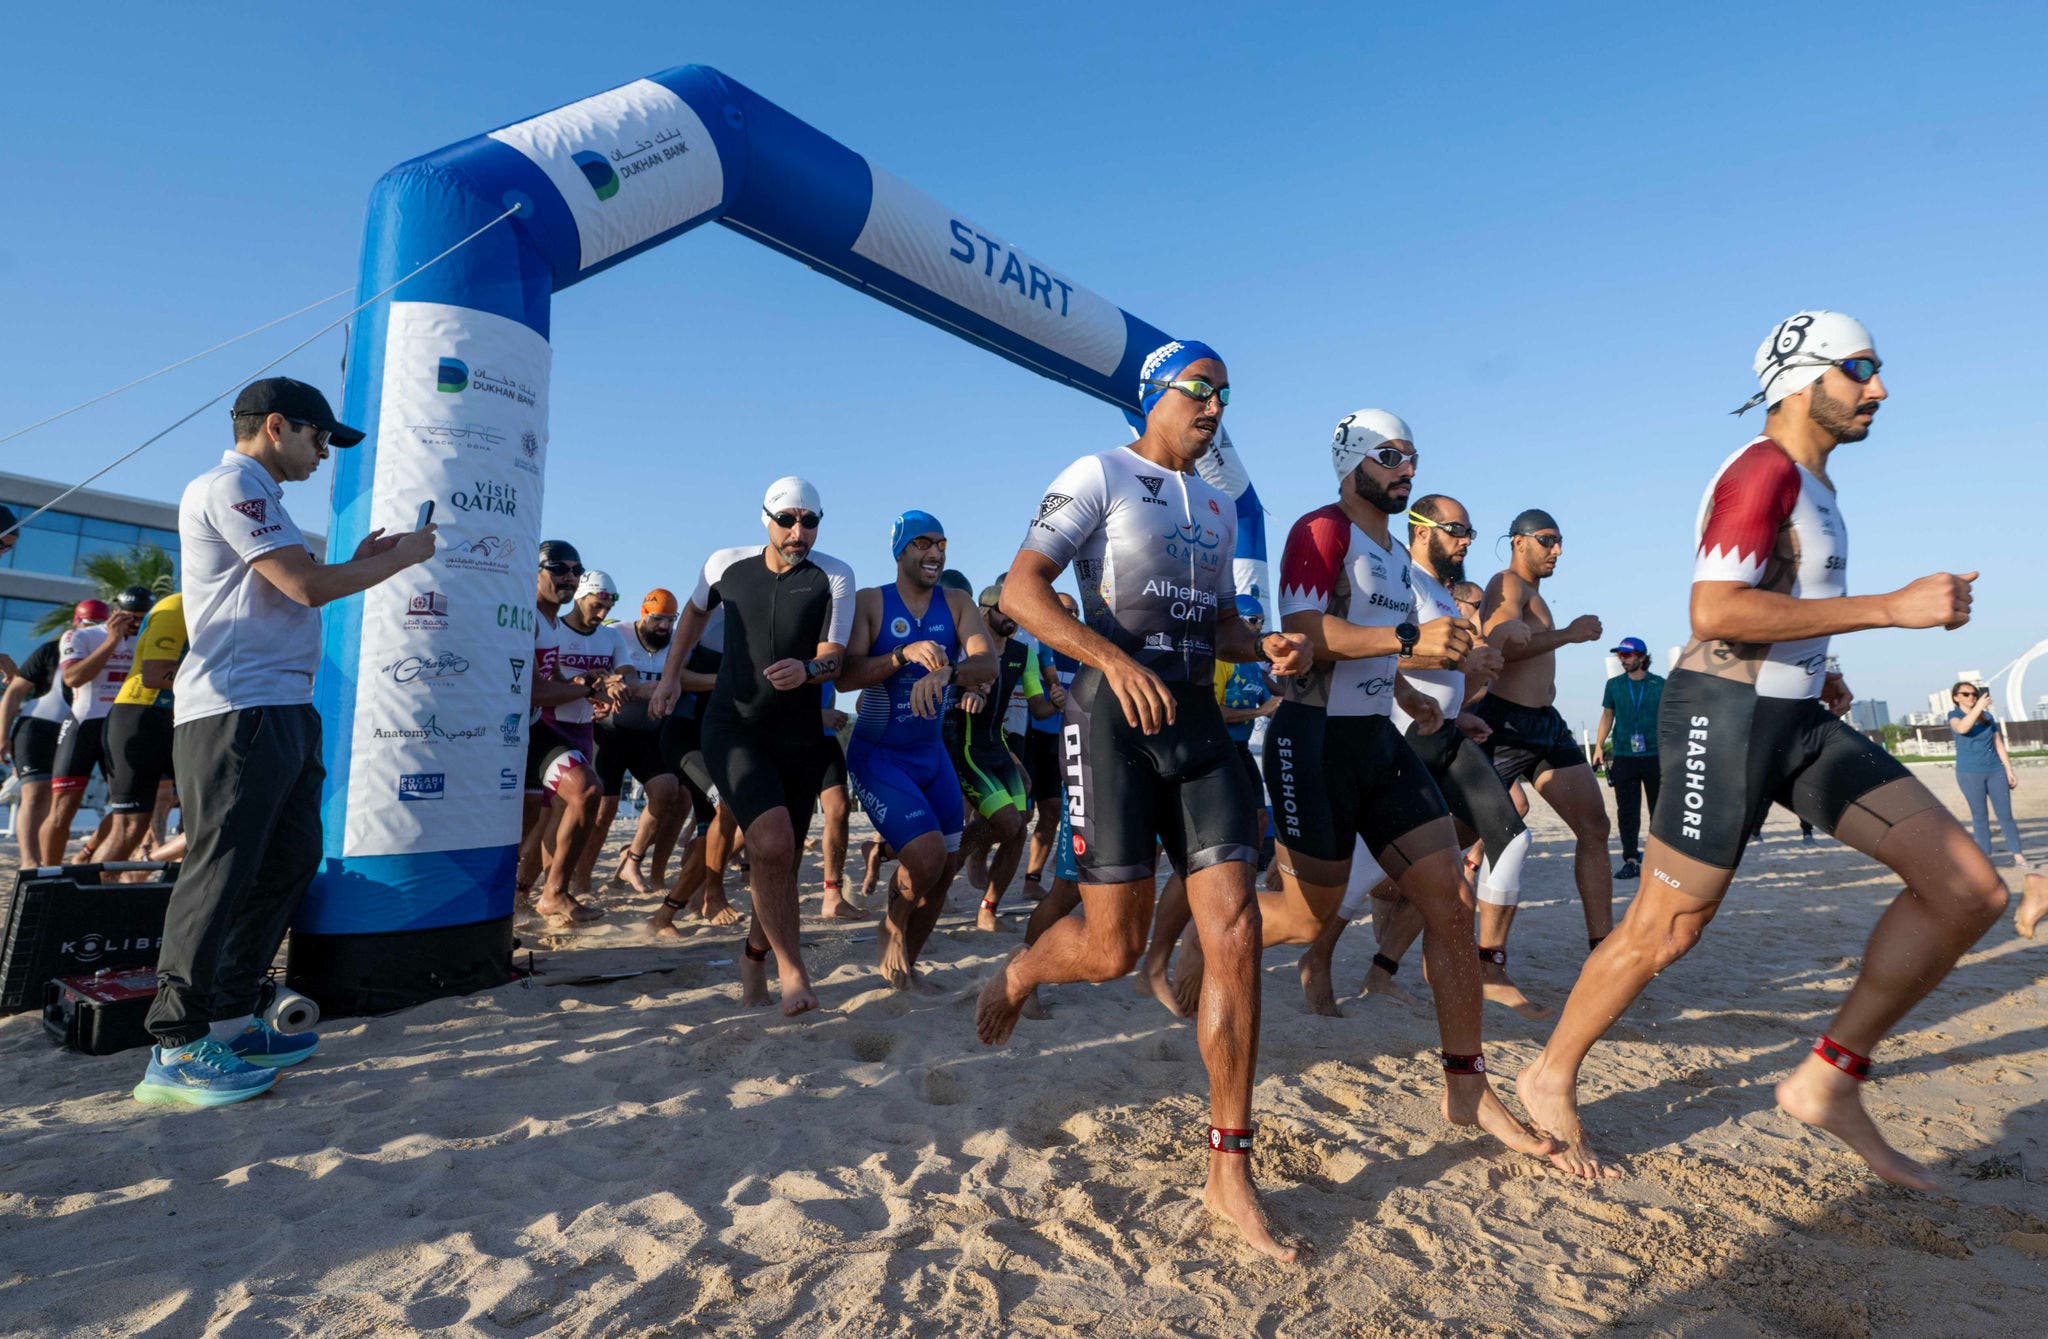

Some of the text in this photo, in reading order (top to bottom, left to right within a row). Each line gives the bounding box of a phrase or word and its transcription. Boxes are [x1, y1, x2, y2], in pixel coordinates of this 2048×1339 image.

[620, 141, 690, 179] DUKHAN BANK
[950, 219, 1073, 317] START
[473, 381, 536, 408] DUKHAN BANK
[475, 481, 517, 501] visit
[1142, 496, 1168, 507] QTRI
[451, 492, 516, 517] QATAR
[1171, 601, 1207, 622] QAT
[566, 656, 610, 665] QATAR
[373, 728, 432, 740] Anatomy
[401, 776, 443, 784] POCARI
[1064, 723, 1085, 828] QTRI
[1682, 715, 1709, 841] SEASHORE
[1277, 737, 1300, 838] SEASHORE
[1653, 868, 1681, 889] VELO
